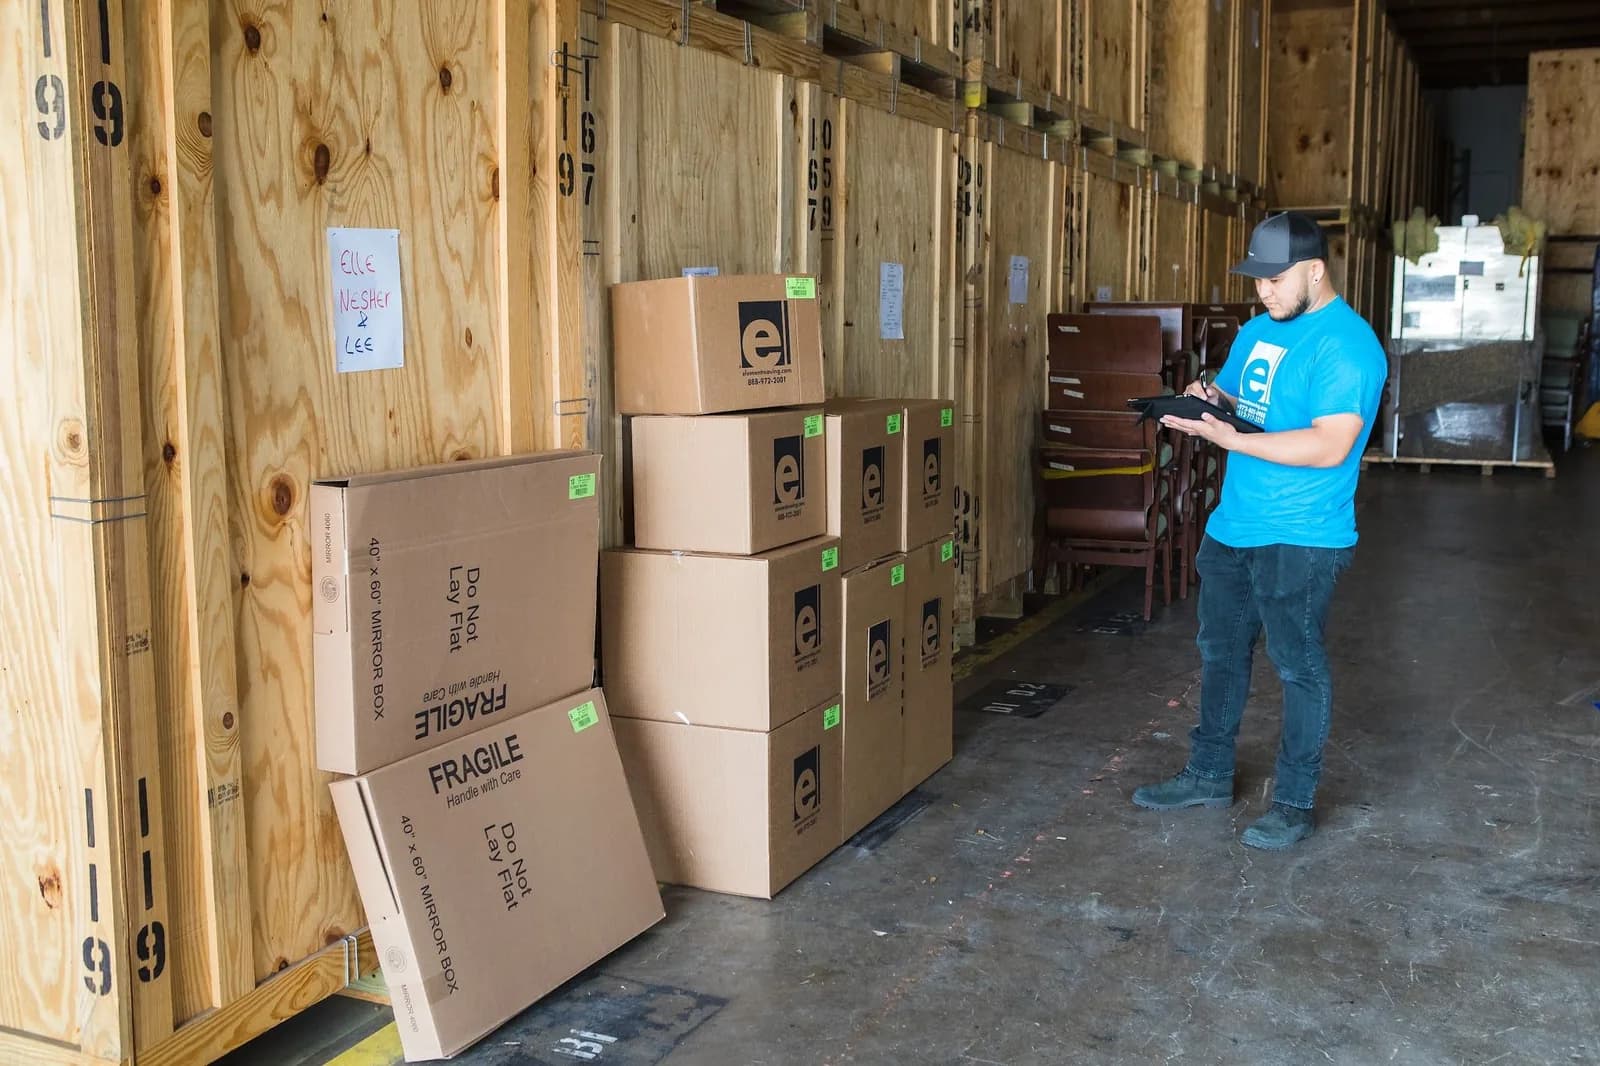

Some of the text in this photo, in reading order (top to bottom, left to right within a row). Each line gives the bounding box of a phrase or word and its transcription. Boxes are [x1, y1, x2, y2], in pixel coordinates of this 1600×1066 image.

[581, 58, 596, 206] 167
[808, 117, 818, 231] 167
[822, 118, 832, 227] 059
[748, 376, 786, 386] 888-972-2001
[446, 565, 463, 653] Lay Flat
[466, 567, 480, 643] Do Not
[371, 610, 383, 681] MIRROR
[373, 683, 385, 720] BOX
[414, 683, 507, 740] FRAGILE
[423, 670, 501, 703] Handle with Care
[428, 734, 524, 794] FRAGILE
[446, 768, 521, 809] Handle with Care
[82, 788, 112, 996] 119
[137, 777, 166, 983] 119
[484, 824, 519, 911] Lay Flat
[501, 822, 532, 898] Do Not
[420, 884, 448, 955] MIRROR
[441, 956, 459, 995] BOX
